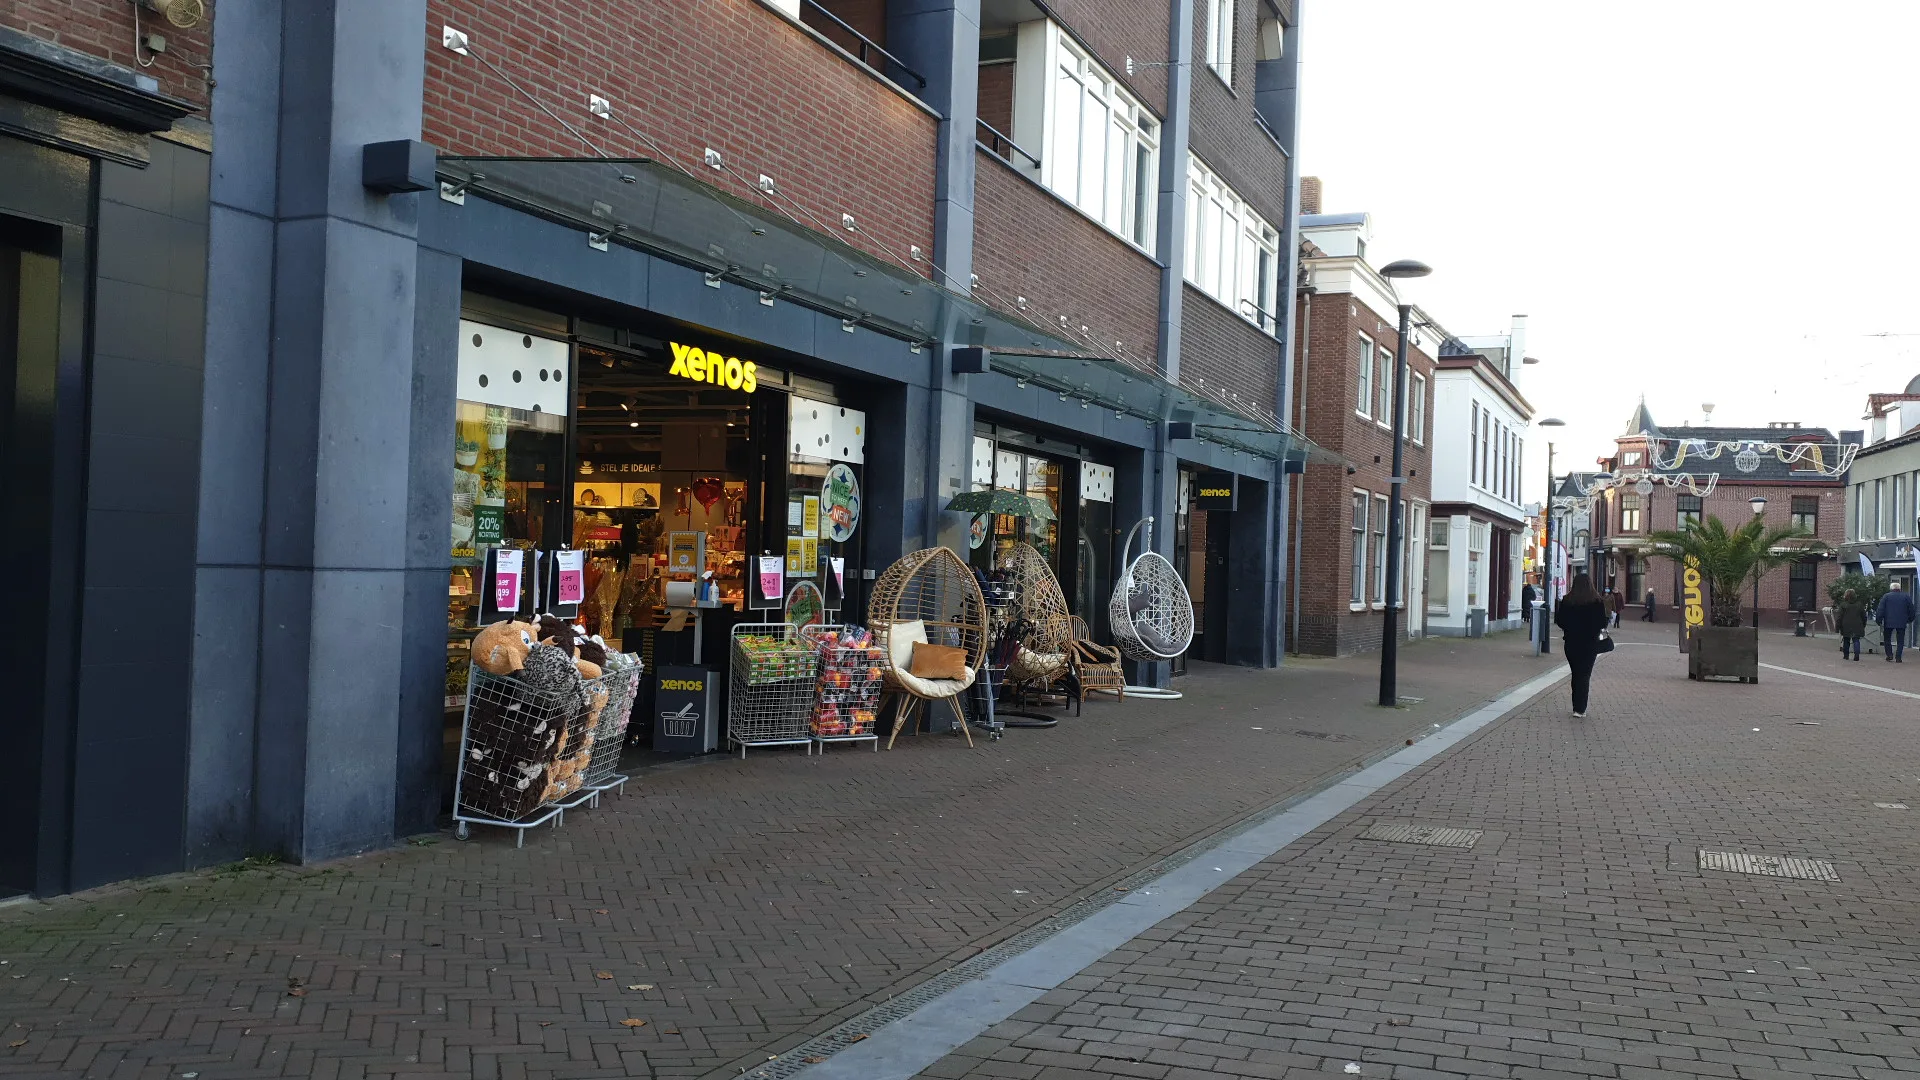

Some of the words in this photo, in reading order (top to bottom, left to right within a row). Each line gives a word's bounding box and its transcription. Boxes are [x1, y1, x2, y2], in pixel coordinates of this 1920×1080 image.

[669, 341, 757, 394] xenos
[600, 463, 618, 472] STEL
[620, 463, 629, 472] JE
[631, 463, 656, 473] IDEALE
[831, 482, 850, 498] NICE
[1200, 488, 1231, 497] xenos
[478, 516, 500, 531] 20%
[833, 507, 850, 525] NEW
[660, 679, 703, 691] xenos
